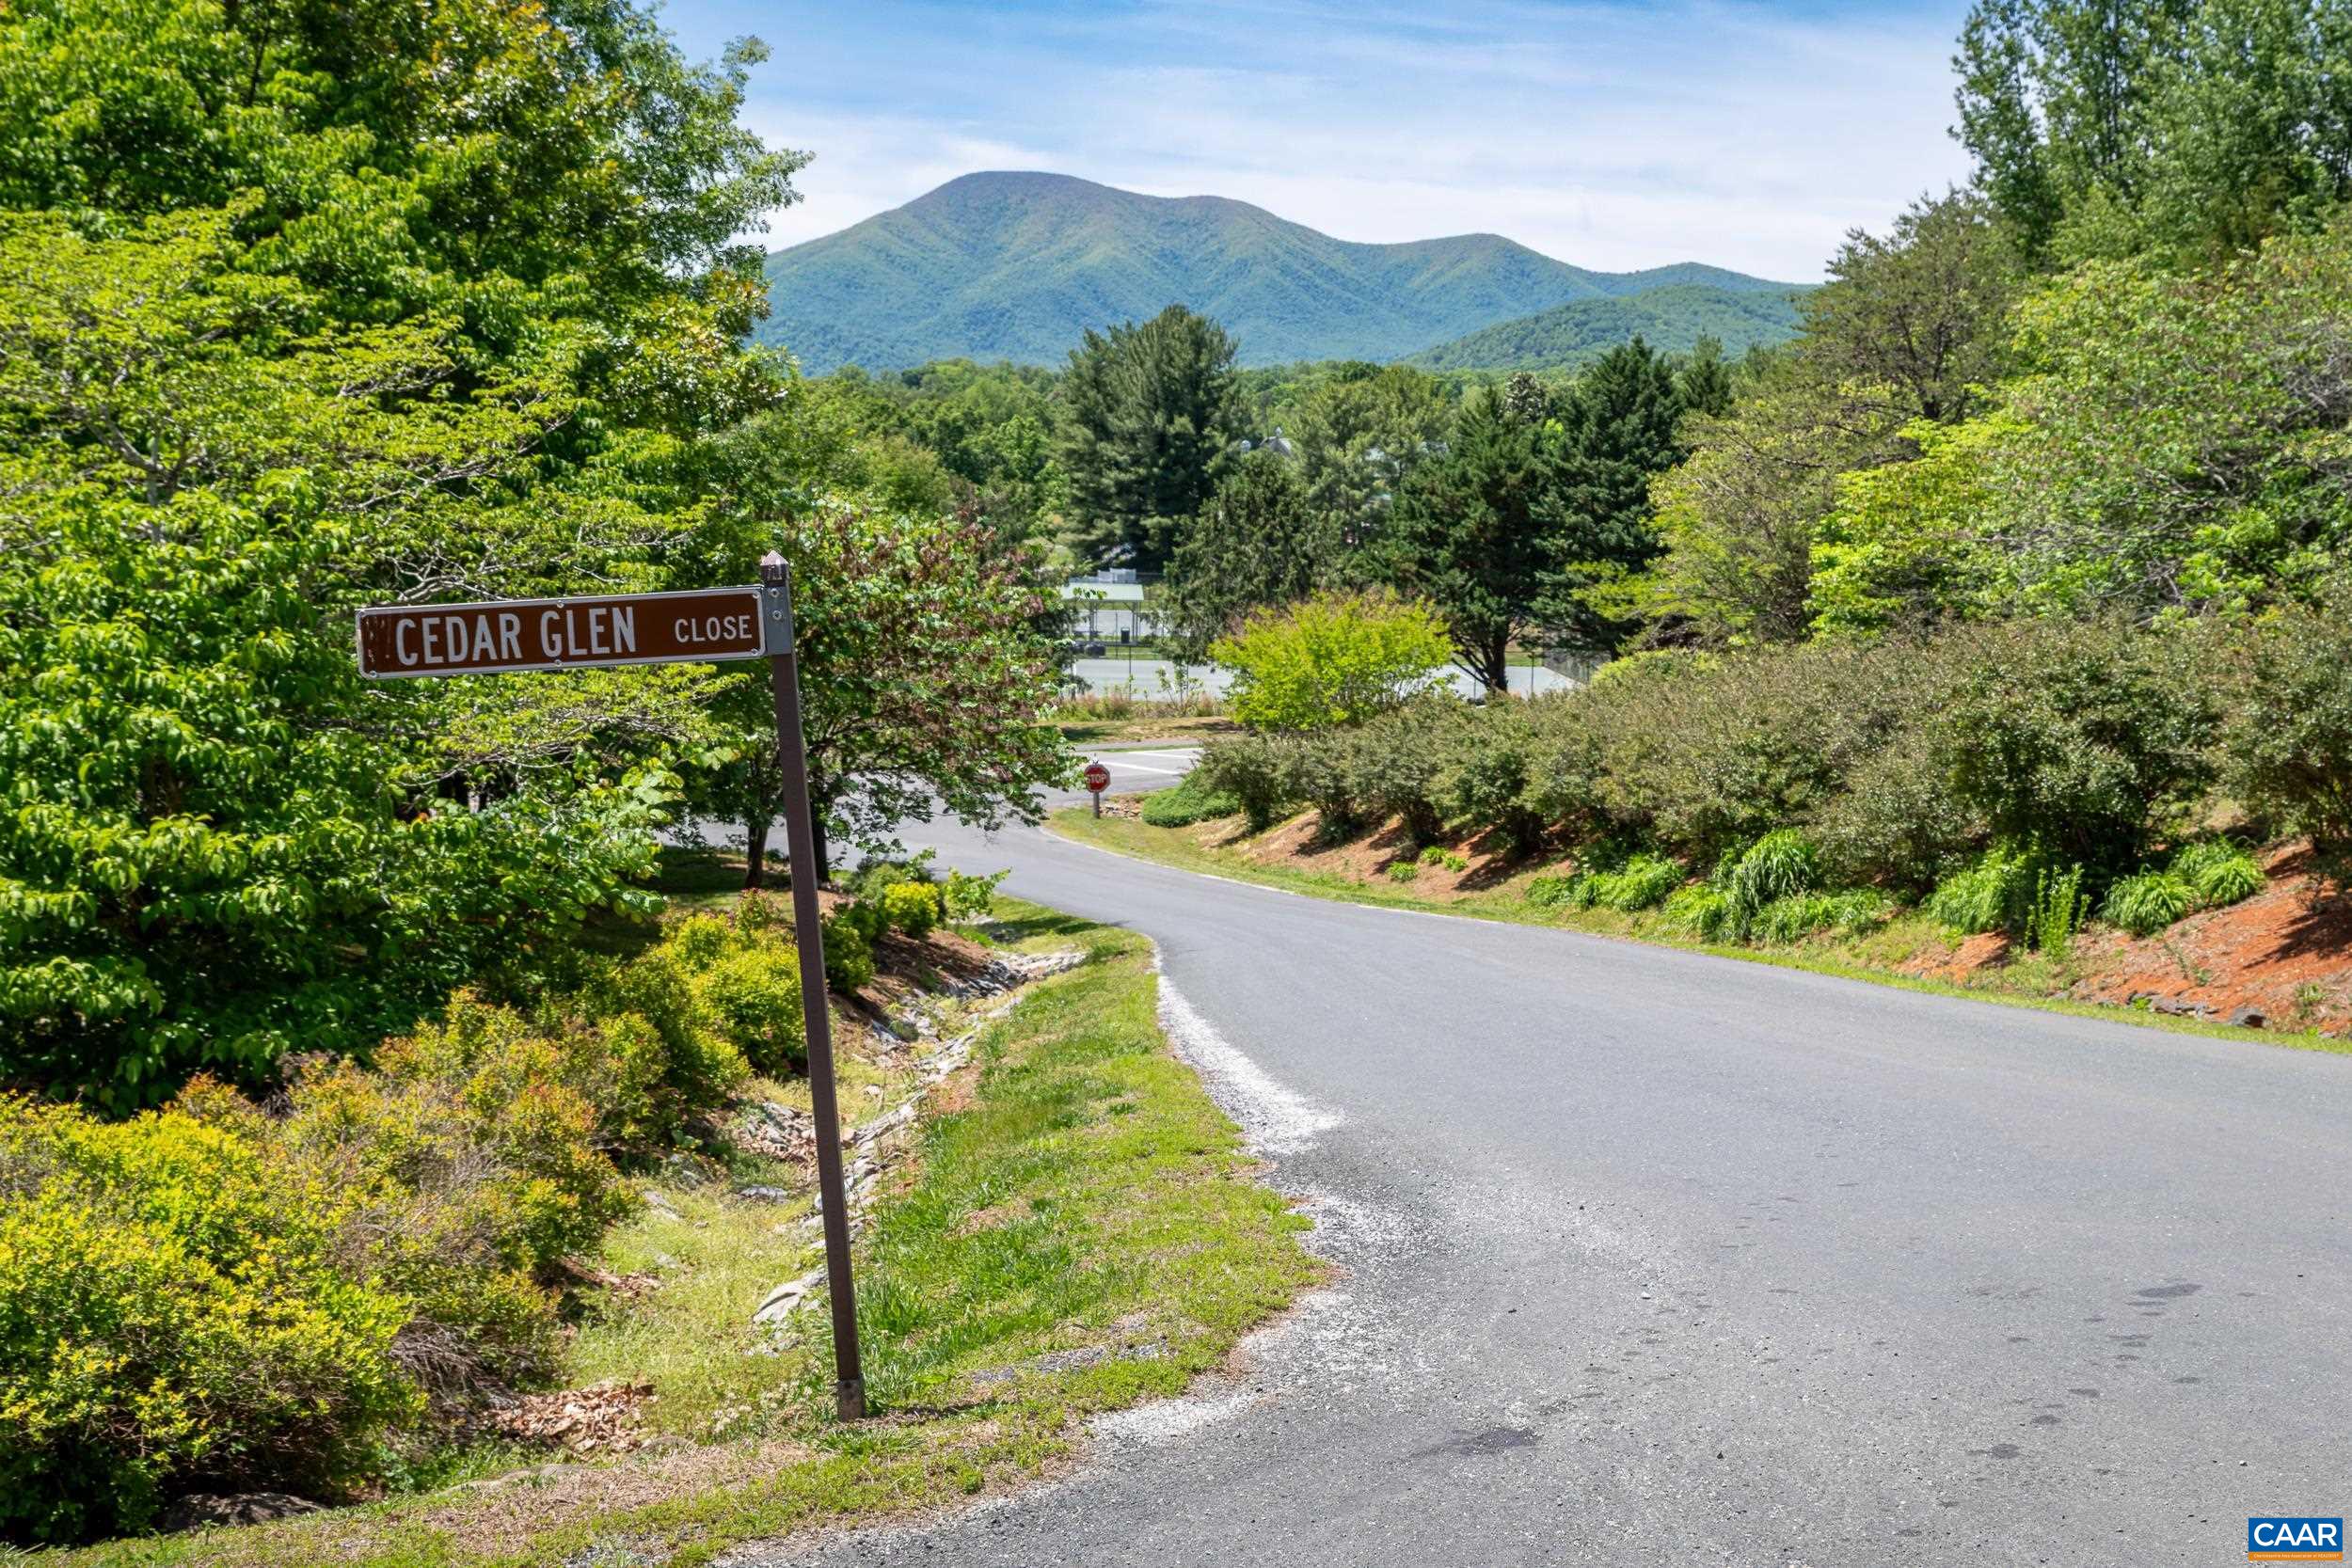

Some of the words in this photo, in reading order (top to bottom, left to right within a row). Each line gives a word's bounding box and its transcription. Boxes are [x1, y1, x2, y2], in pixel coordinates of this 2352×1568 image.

[396, 613, 521, 666] CEDAR
[540, 607, 636, 657] GLEN
[675, 615, 753, 642] CLOSE
[1085, 773, 1106, 784] STOP
